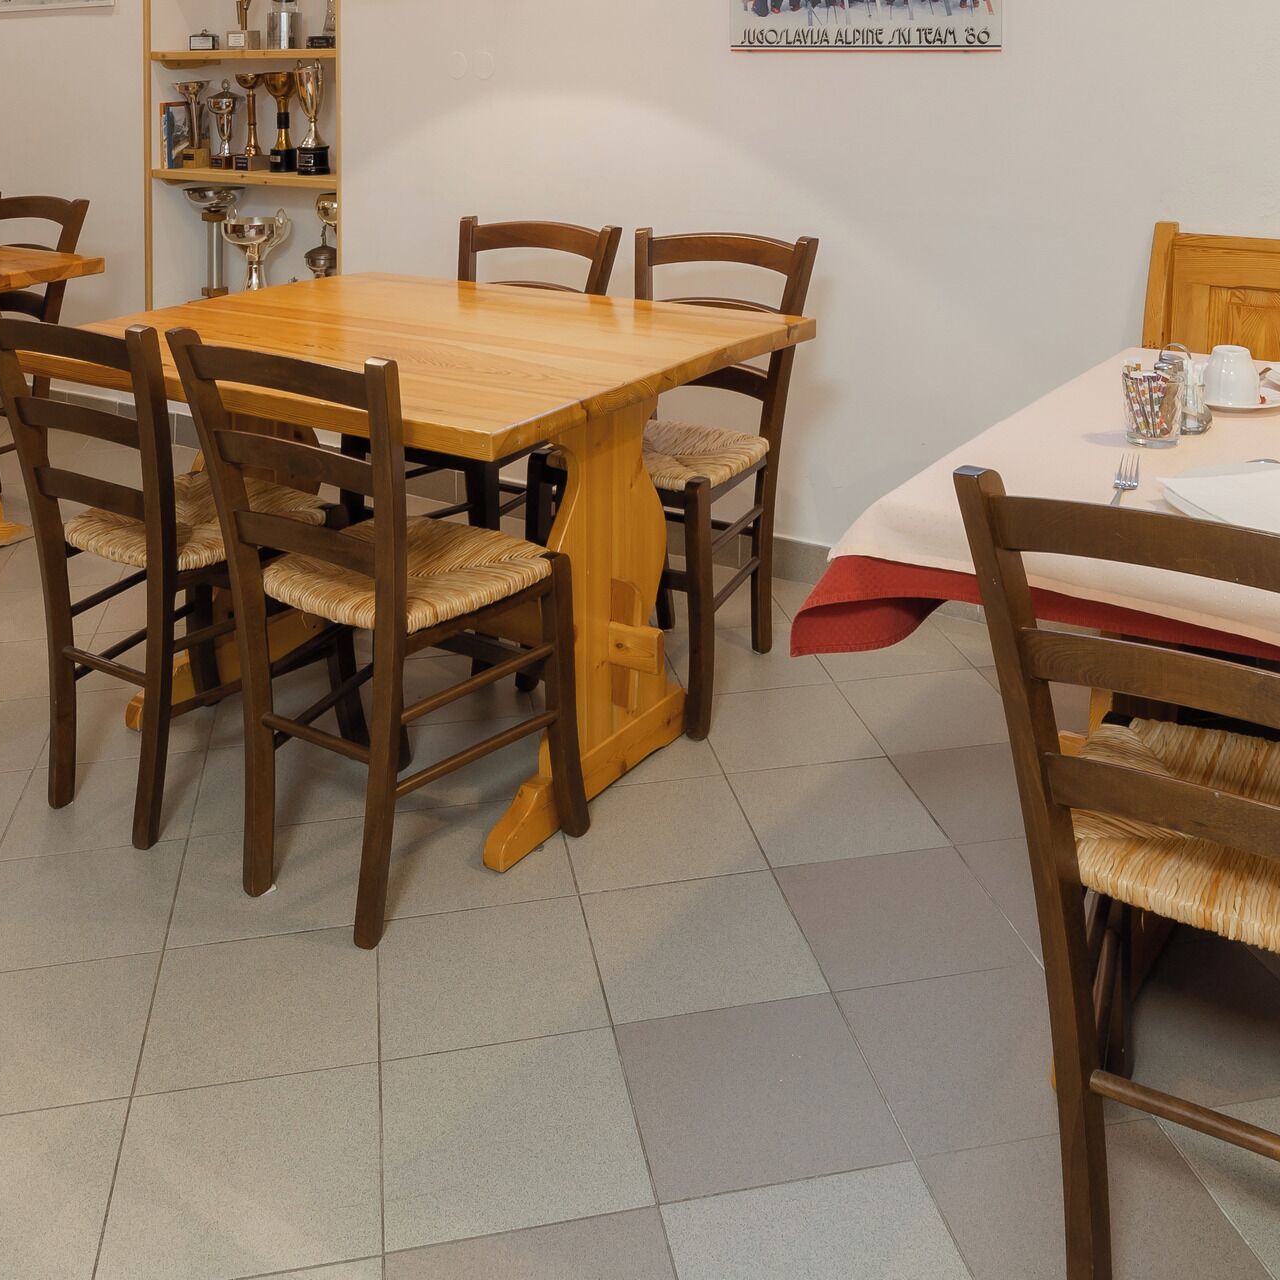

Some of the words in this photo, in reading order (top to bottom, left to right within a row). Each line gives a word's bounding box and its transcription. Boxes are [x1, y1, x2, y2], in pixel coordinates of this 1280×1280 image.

[740, 27, 830, 45] JUGOSLAVIJA
[834, 27, 883, 45] ALPINE
[888, 26, 912, 45] SKI
[915, 26, 957, 45] TEAM
